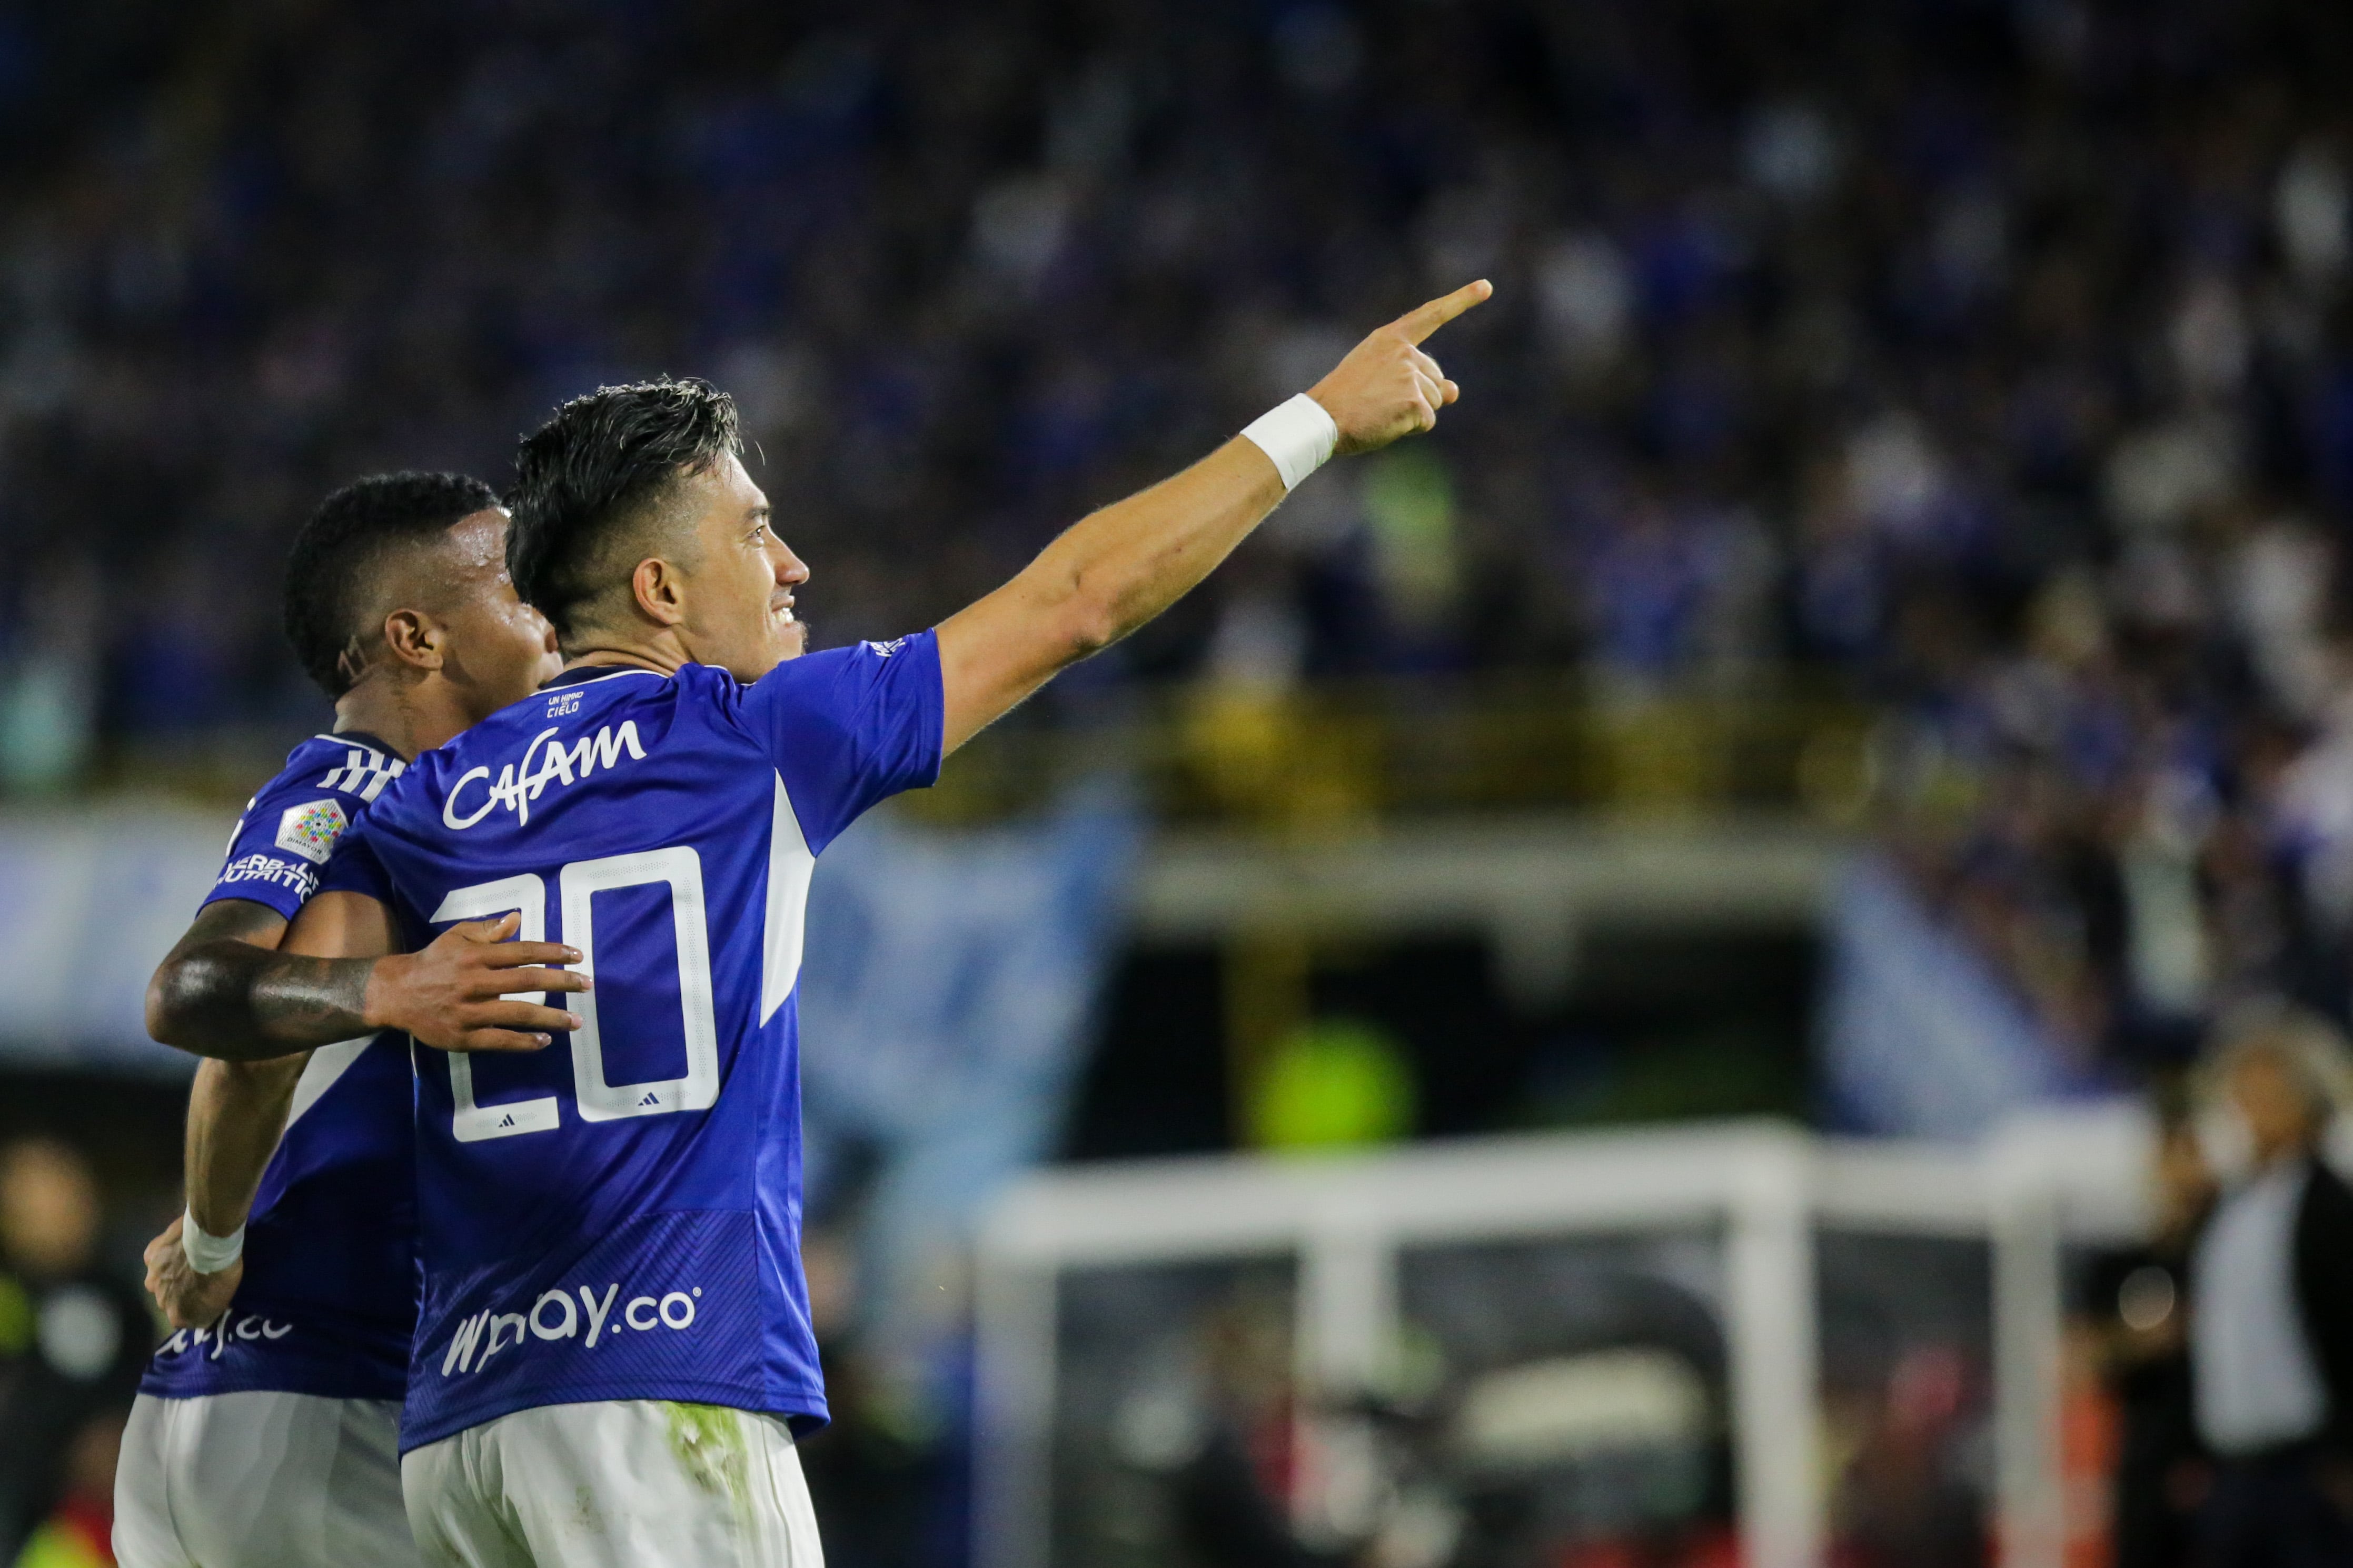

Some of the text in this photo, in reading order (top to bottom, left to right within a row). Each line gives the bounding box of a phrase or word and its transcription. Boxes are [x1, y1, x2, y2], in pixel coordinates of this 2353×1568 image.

[548, 691, 584, 705] UN HIMNO
[547, 701, 579, 718] CIELO
[287, 837, 322, 855] DIMAYOR
[429, 845, 720, 1142] 20
